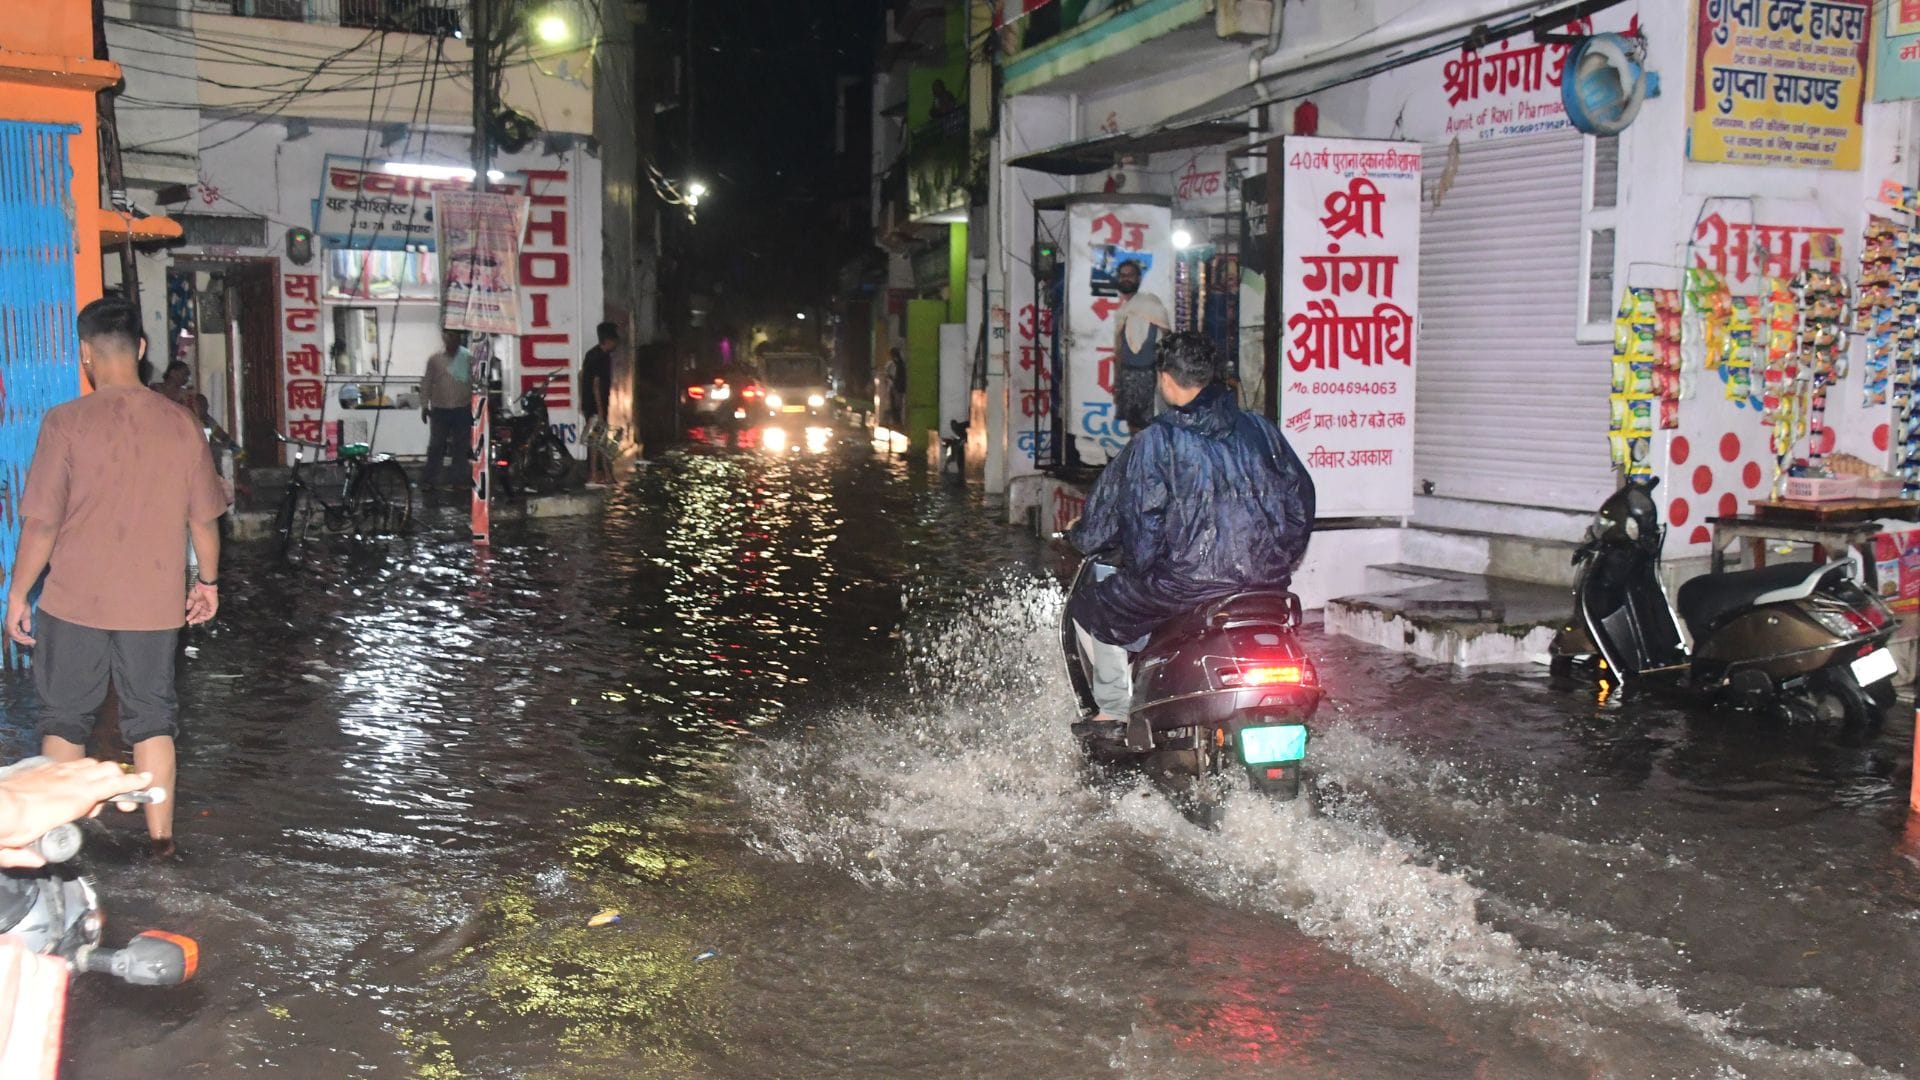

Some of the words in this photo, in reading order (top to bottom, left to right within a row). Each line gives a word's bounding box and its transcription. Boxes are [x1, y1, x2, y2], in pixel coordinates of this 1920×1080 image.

[1484, 39, 1546, 95] गंगा
[1712, 67, 1767, 114] गुप्ता
[1773, 73, 1841, 110] साउण्ड
[1178, 158, 1222, 200] दीपक
[1289, 152, 1312, 169] 40
[1319, 177, 1385, 240] श्री
[1300, 243, 1399, 299] गंगा
[1287, 298, 1413, 373] औषधि
[1312, 382, 1397, 394] 8004694063
[1360, 414, 1367, 427] 7
[1387, 412, 1406, 428] तक
[1307, 445, 1345, 468] रविवार
[1347, 449, 1393, 467] अवकाश
